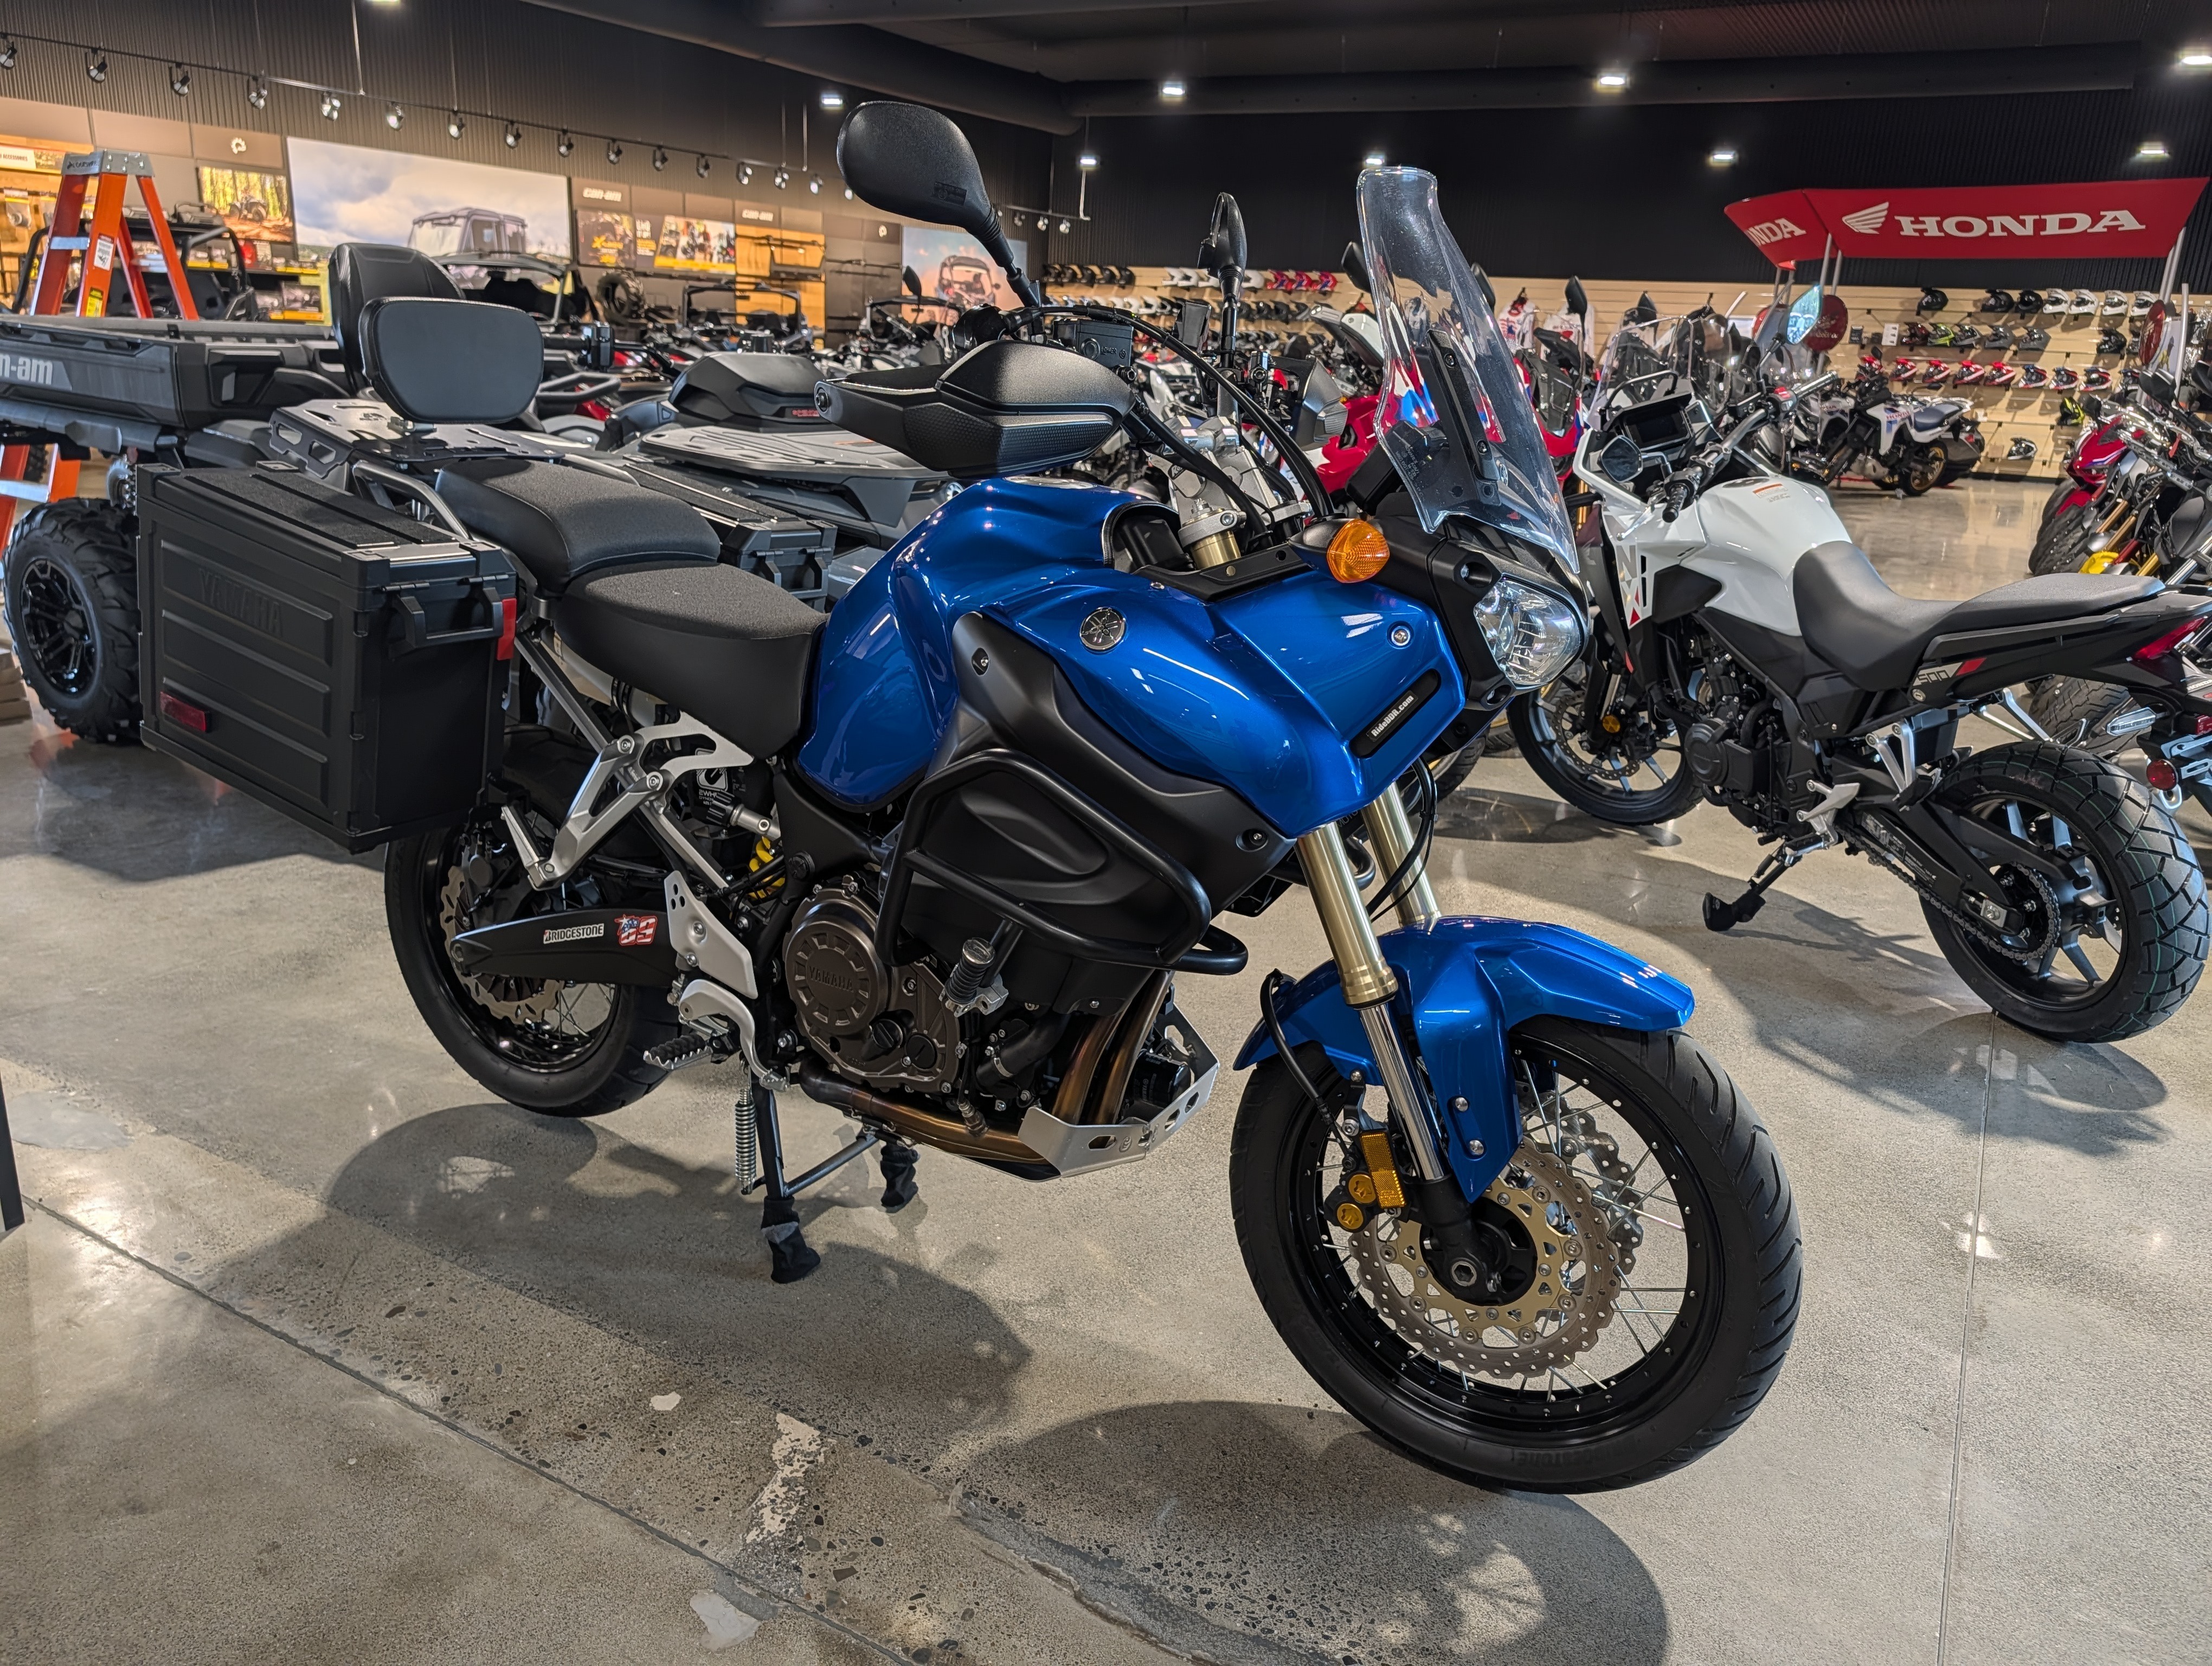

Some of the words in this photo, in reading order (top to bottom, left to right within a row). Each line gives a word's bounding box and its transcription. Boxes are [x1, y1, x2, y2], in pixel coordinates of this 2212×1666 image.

[1894, 209, 2146, 238] HONDA
[1371, 695, 1414, 737] RideBDR.com
[544, 924, 603, 943] BRIDGESTONE
[621, 916, 657, 944] 69
[809, 965, 854, 994] YAMAHA
